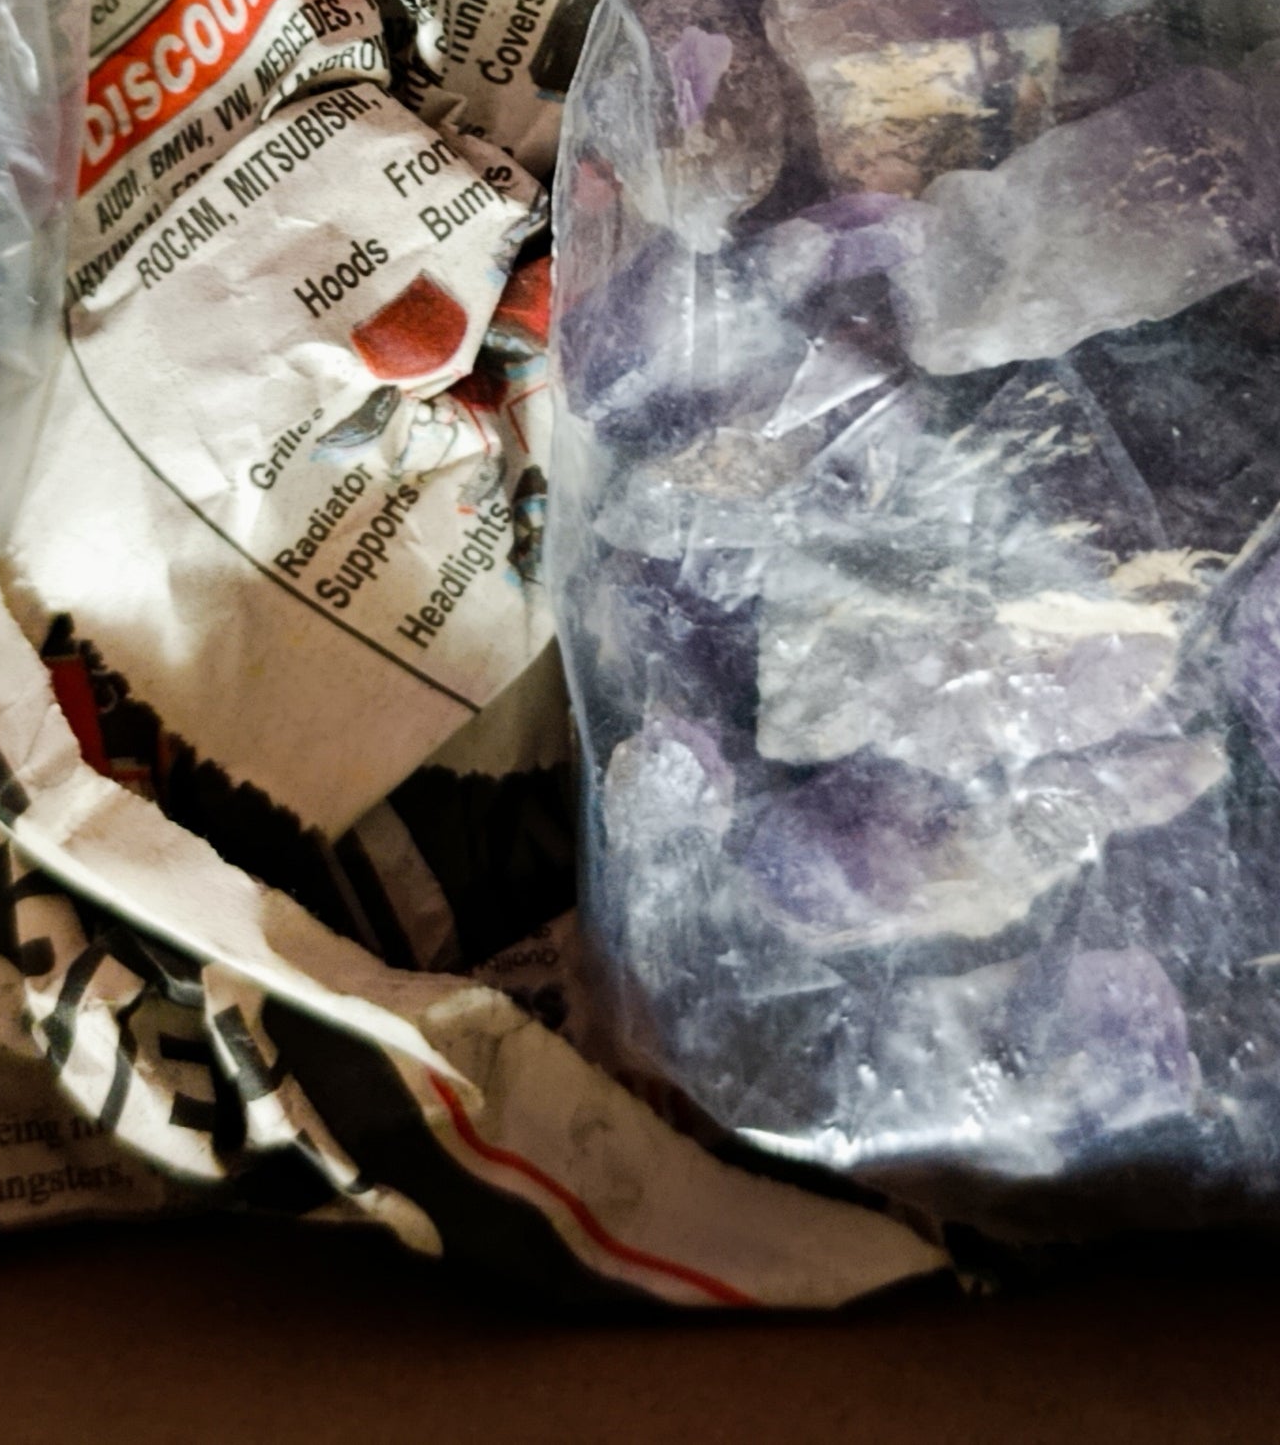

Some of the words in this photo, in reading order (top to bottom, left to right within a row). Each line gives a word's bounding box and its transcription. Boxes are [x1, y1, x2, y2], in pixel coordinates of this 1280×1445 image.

[136, 197, 239, 290] ROCAM,
[222, 84, 384, 210] MITSUBISHI,
[381, 138, 458, 200] Fron
[293, 235, 390, 318] Hoods
[273, 460, 375, 581] Radiator
[315, 480, 421, 612] Supports
[395, 499, 514, 650] Headlights
